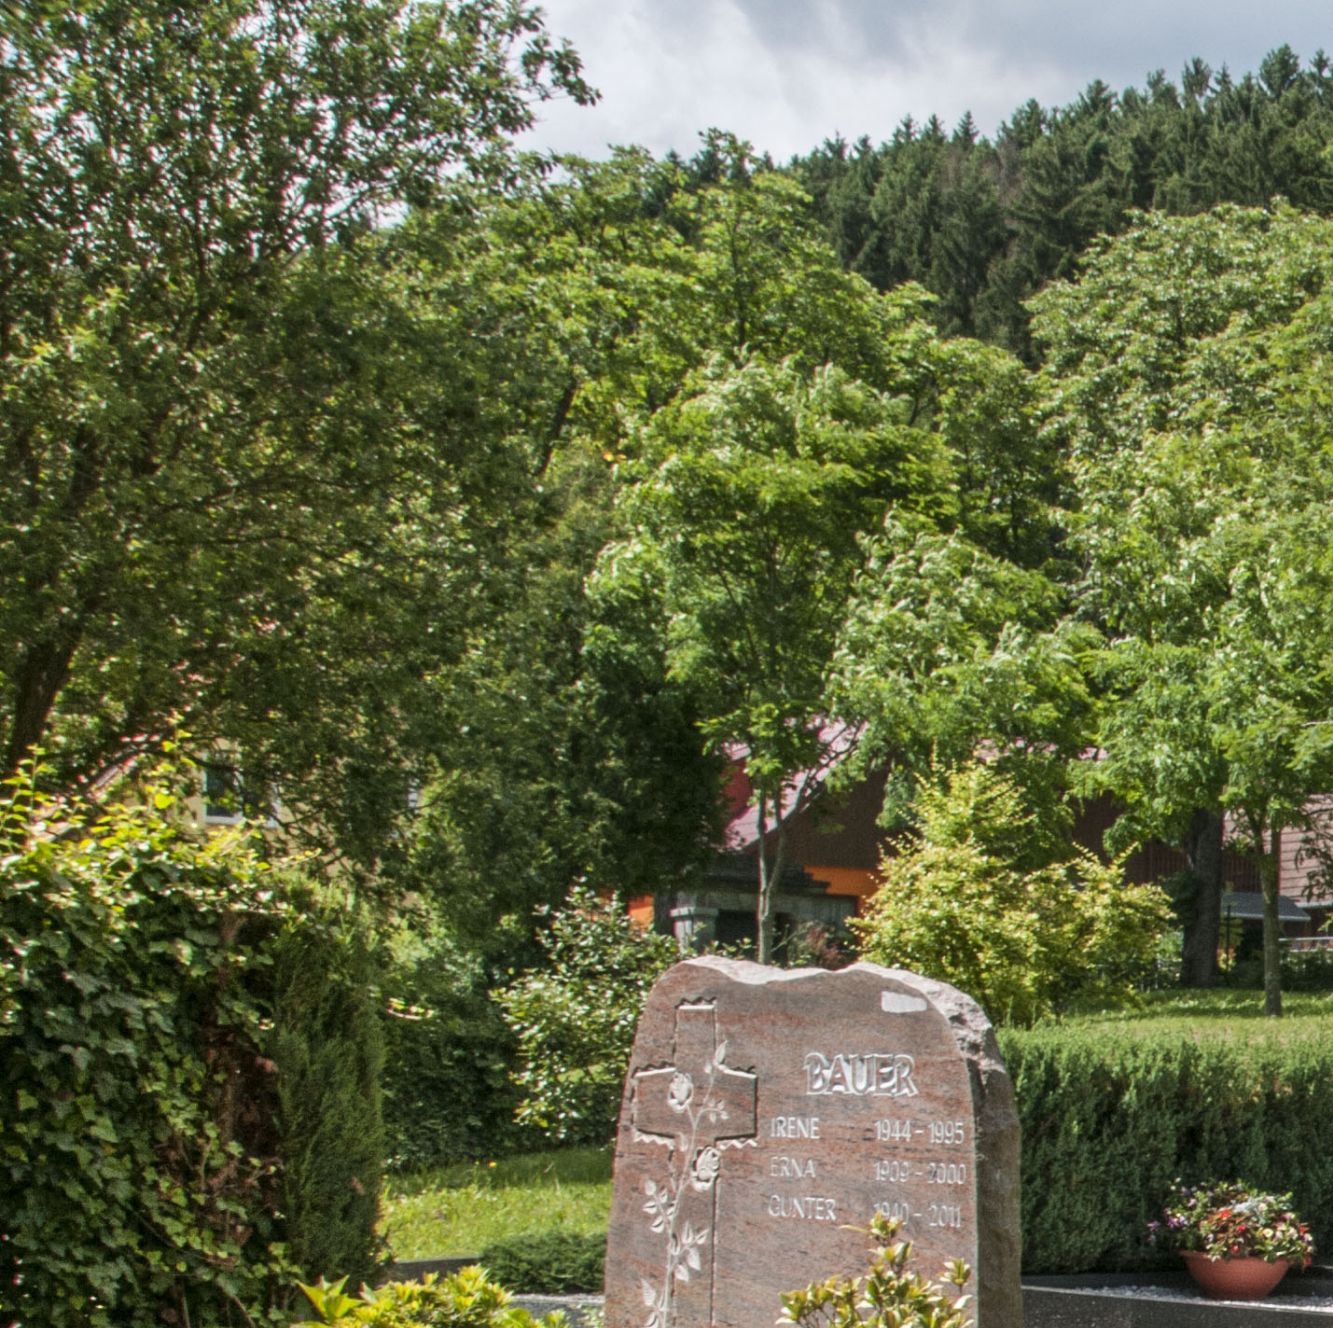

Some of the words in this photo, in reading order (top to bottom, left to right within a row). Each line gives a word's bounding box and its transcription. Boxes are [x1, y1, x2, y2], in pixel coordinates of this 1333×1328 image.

[804, 1053, 918, 1098] BAUER
[770, 1116, 820, 1139] IRENE
[874, 1119, 912, 1142] 1944
[928, 1120, 965, 1145] 1995
[770, 1156, 817, 1178] ERNA
[927, 1162, 966, 1185] 2000
[928, 1204, 961, 1228] 2011
